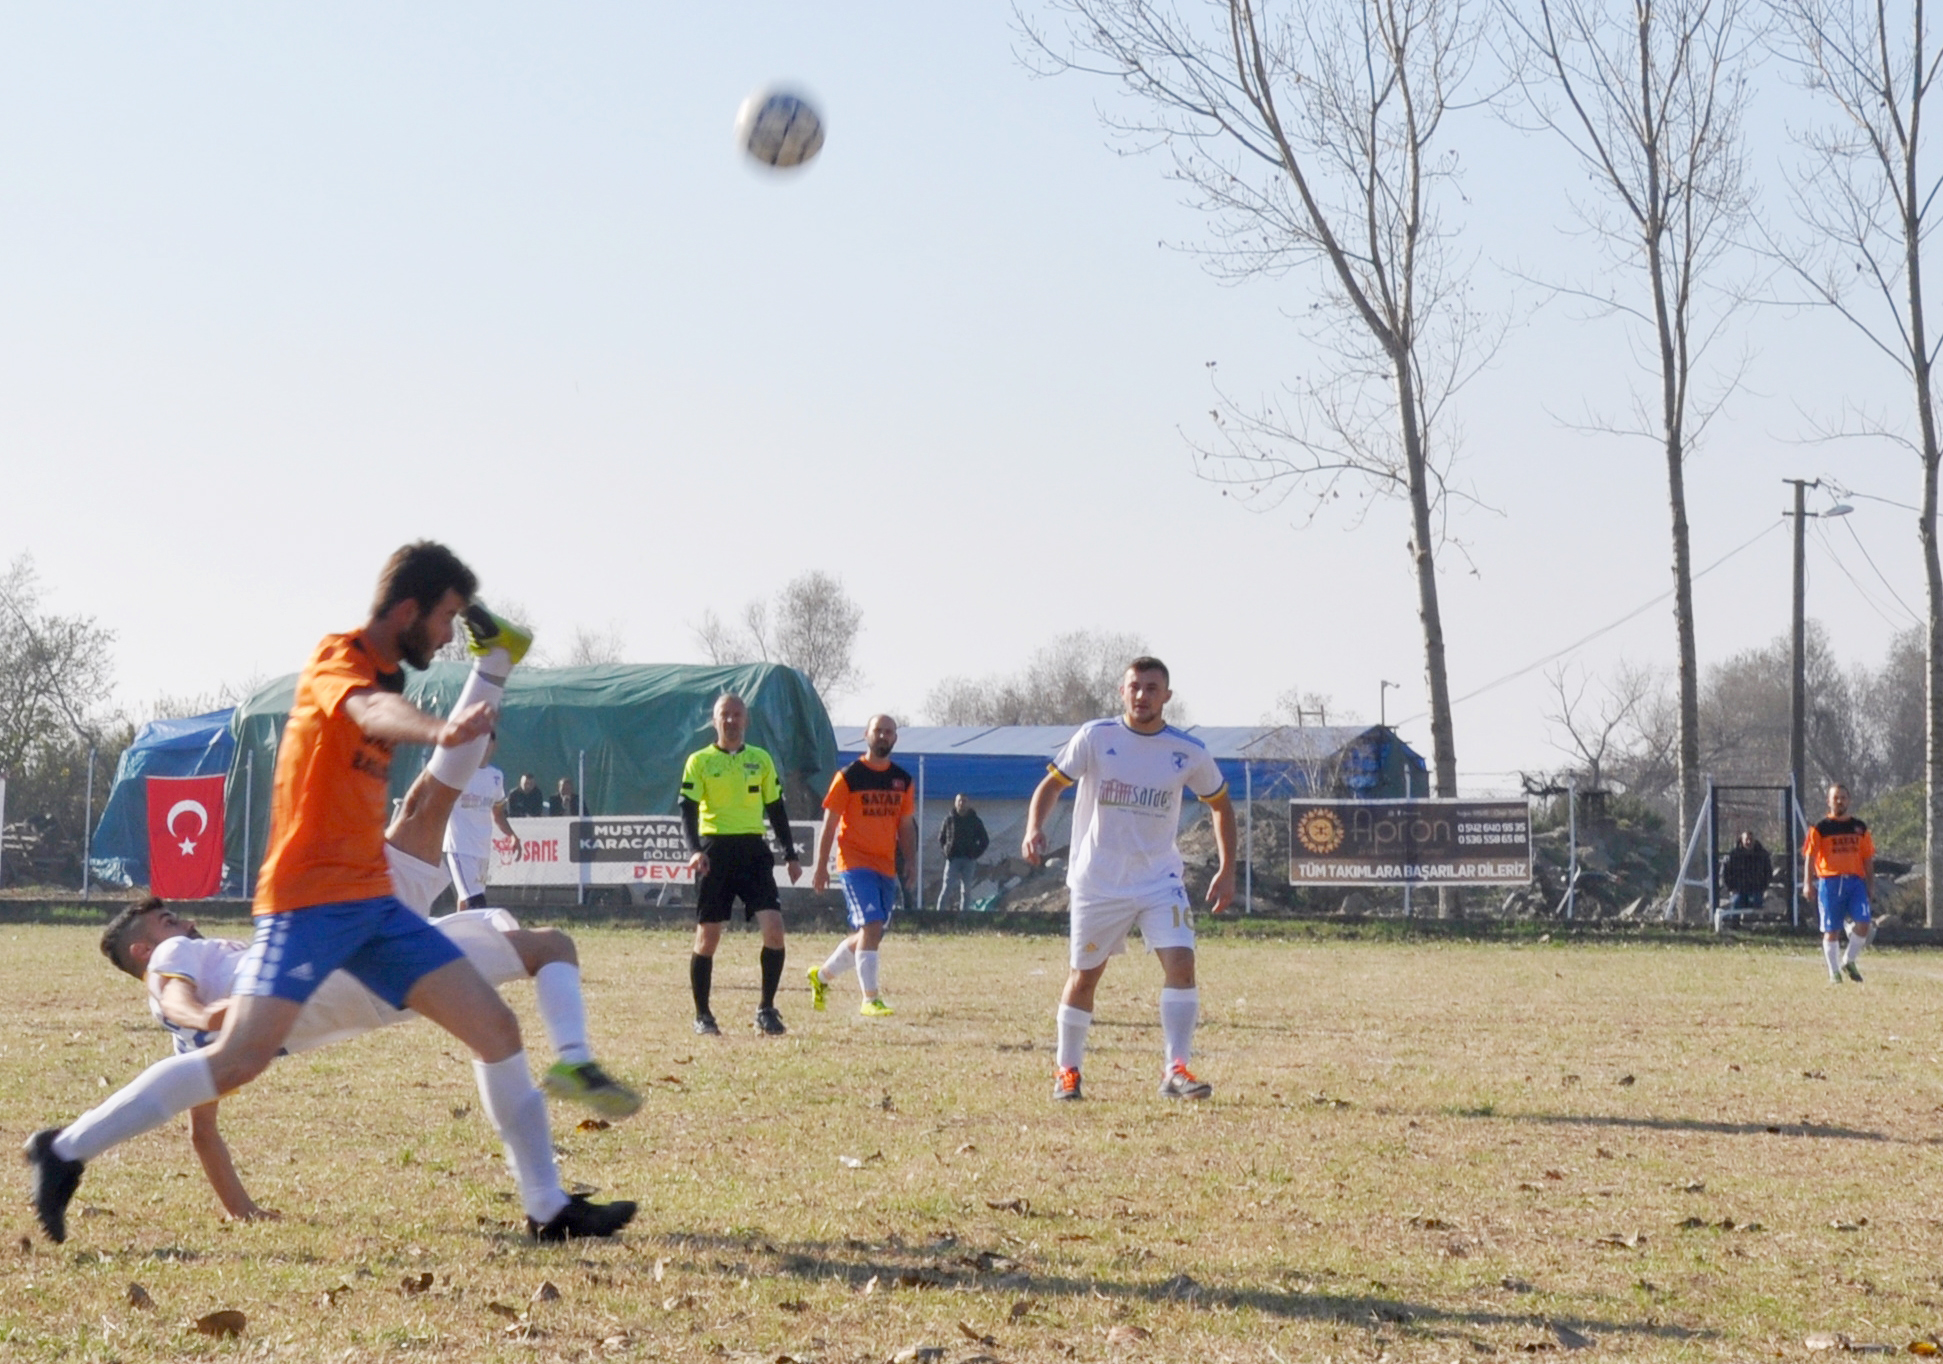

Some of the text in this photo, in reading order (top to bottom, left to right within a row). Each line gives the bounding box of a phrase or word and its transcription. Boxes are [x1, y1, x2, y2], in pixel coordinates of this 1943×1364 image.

[1350, 808, 1451, 854] Apron
[1457, 823, 1465, 833] 0
[580, 837, 688, 849] KARACABEY
[1458, 834, 1465, 845] 0
[523, 839, 558, 862] SAME
[1299, 861, 1527, 880] TÜM TAKIMLARA BAŞARILAR DİLERİZ
